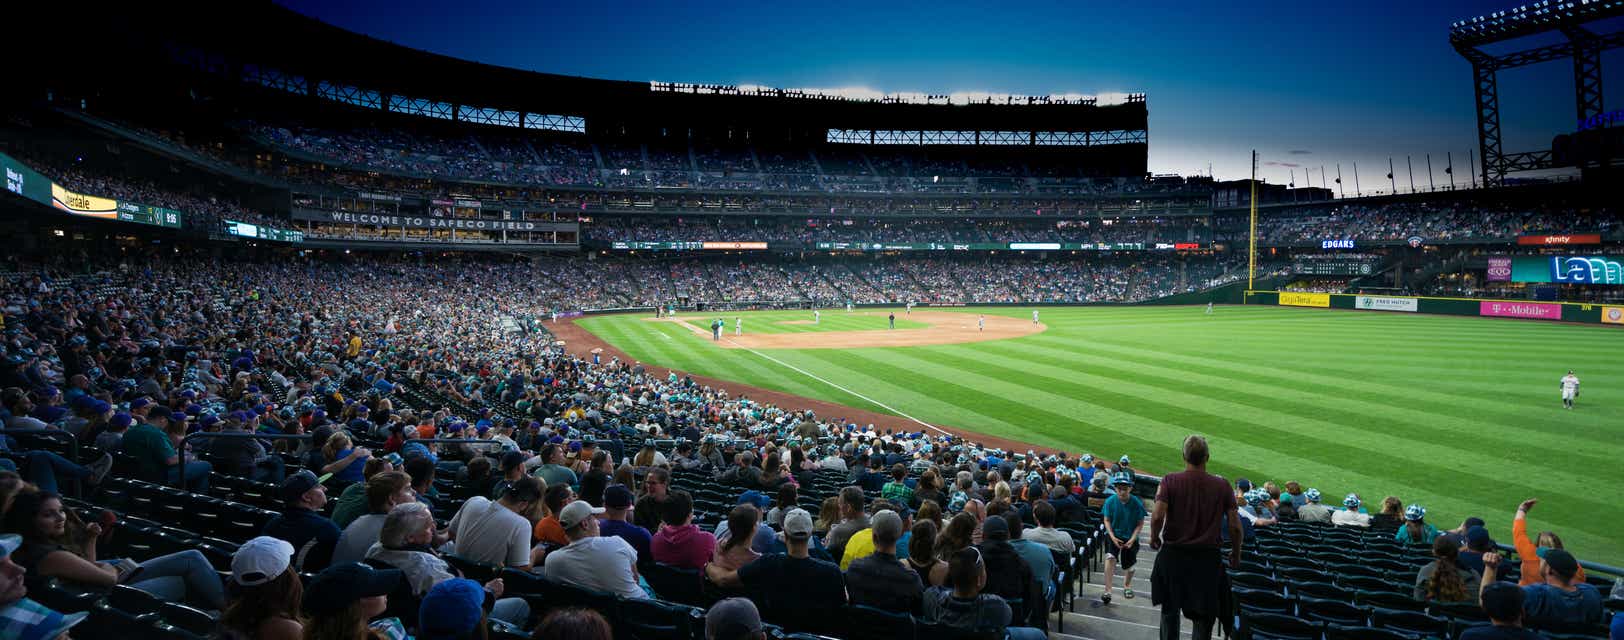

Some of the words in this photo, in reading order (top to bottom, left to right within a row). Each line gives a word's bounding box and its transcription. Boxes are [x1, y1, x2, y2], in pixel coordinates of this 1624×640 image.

[332, 211, 398, 225] WELCOME
[404, 217, 422, 226] TO
[429, 219, 486, 229] SAFECO
[492, 221, 535, 230] FIELD
[1545, 235, 1570, 244] xfinity
